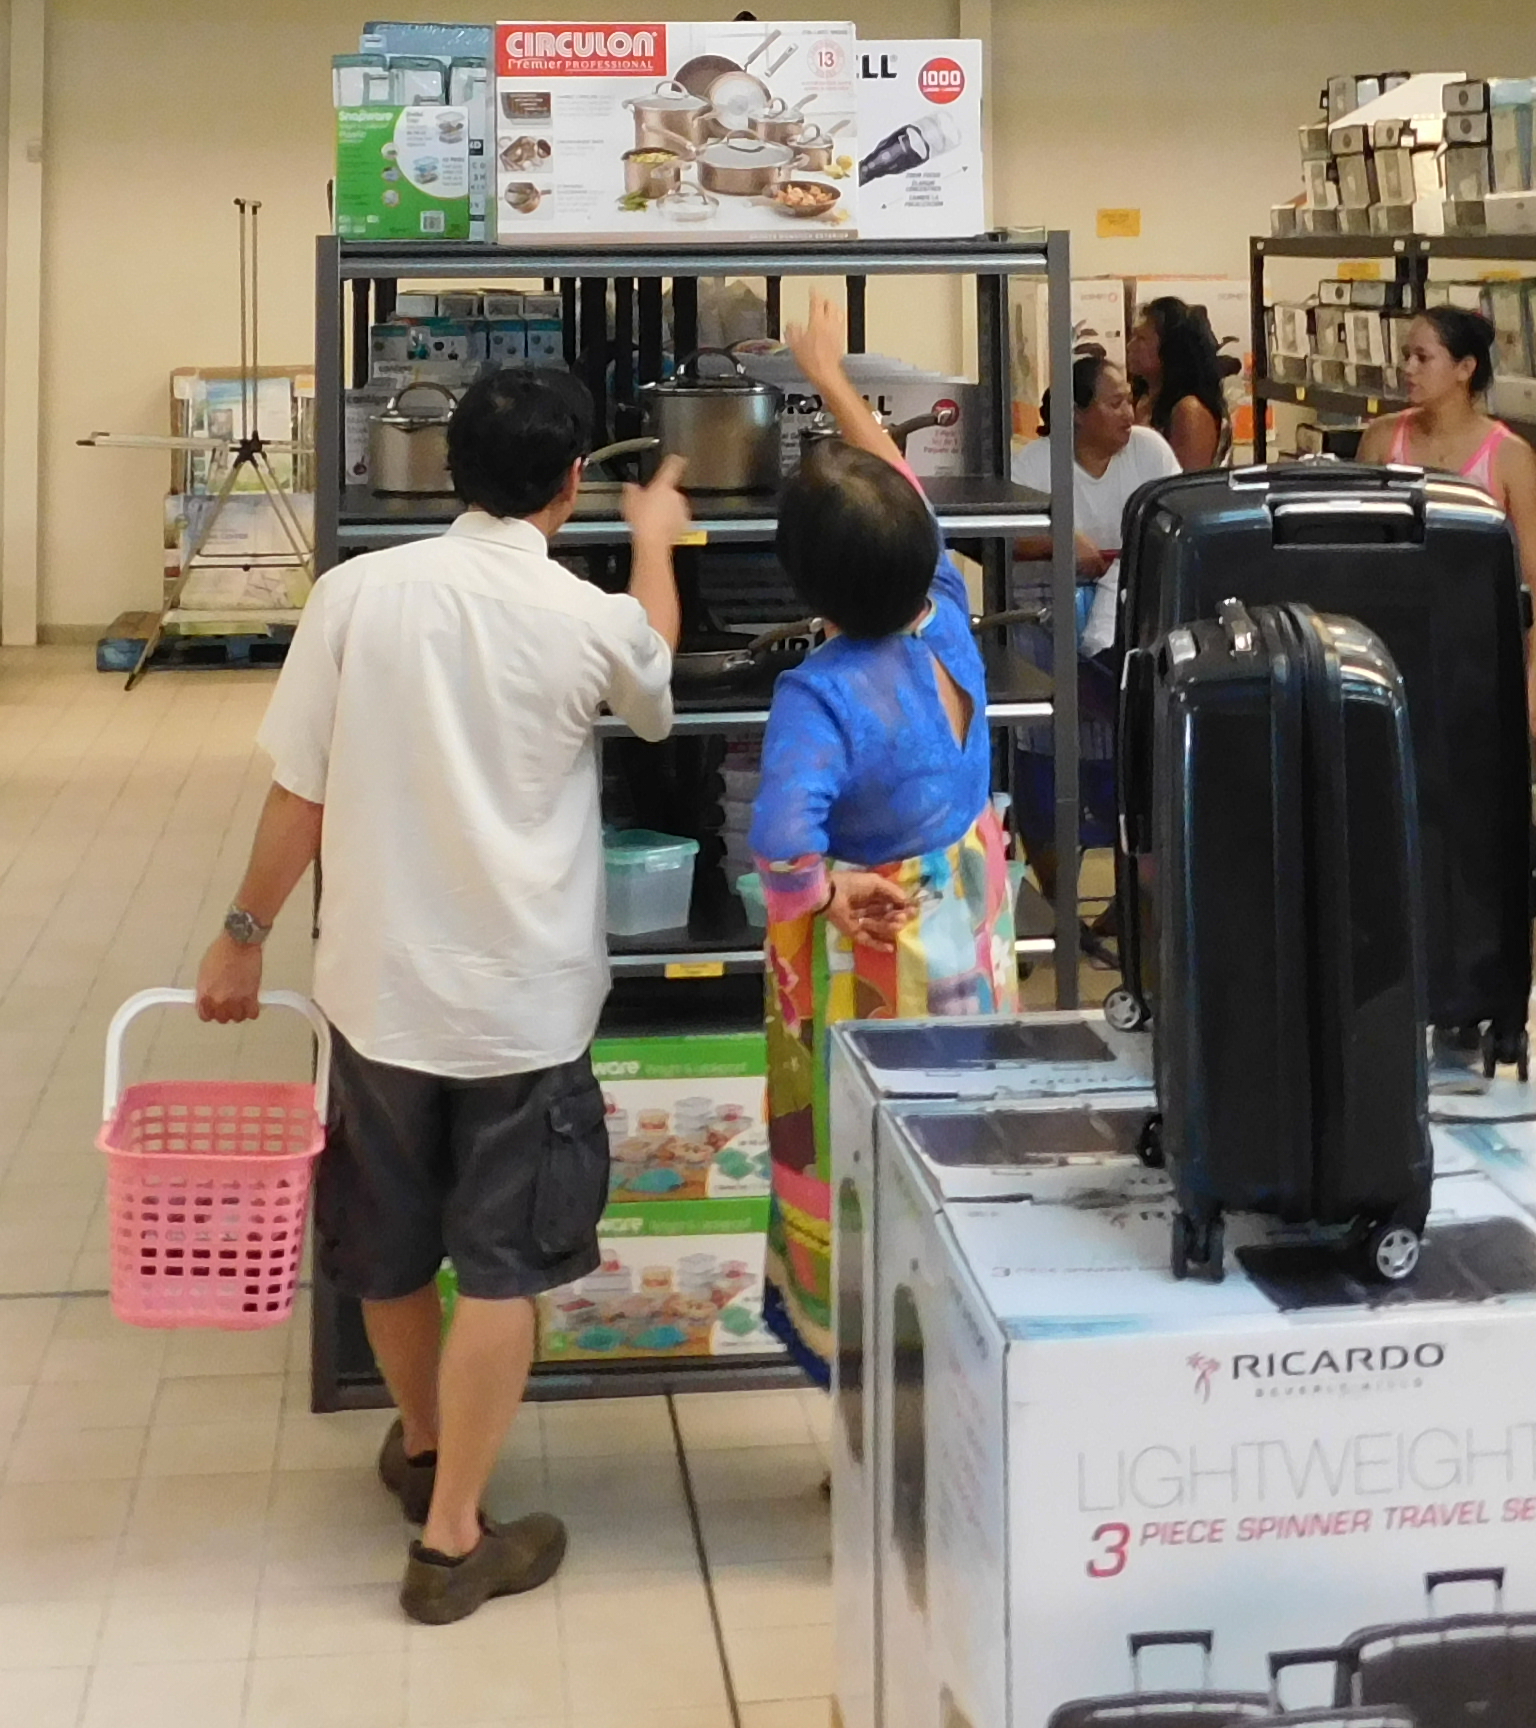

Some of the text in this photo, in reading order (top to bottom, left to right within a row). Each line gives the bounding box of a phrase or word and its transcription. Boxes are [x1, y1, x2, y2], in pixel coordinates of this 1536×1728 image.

[505, 31, 654, 58] CIRCULON
[507, 57, 654, 70] Premier PROFESSIONAL
[817, 51, 835, 68] 13
[922, 70, 961, 86] 1000
[1231, 1342, 1446, 1381] RICARDO
[1085, 1521, 1131, 1579] 3
[1139, 1518, 1226, 1547] PIECE
[1235, 1508, 1373, 1543] SPINNER
[1383, 1498, 1491, 1532] TRAVEL
